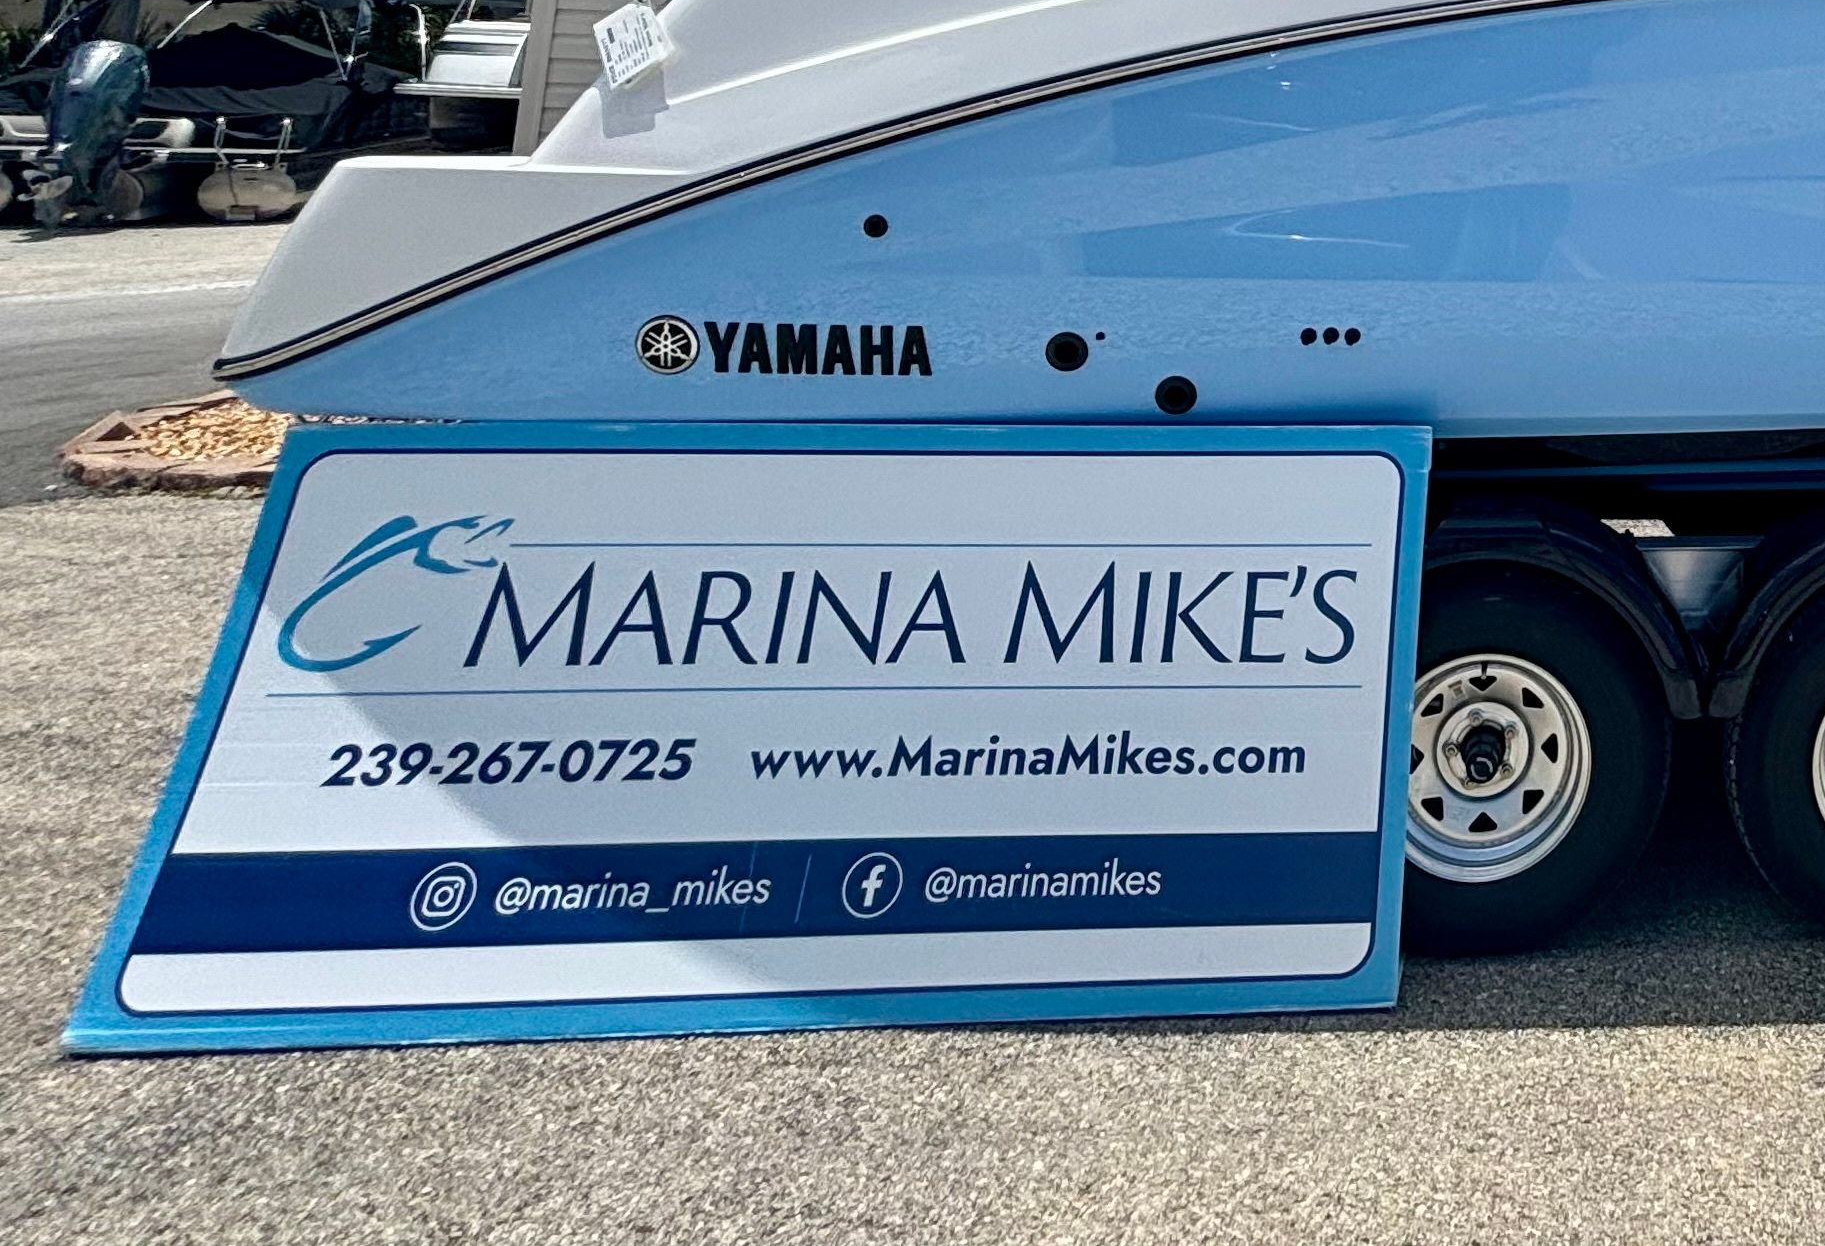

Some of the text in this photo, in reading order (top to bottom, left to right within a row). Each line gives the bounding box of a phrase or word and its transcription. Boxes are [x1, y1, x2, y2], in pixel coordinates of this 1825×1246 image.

[704, 322, 933, 375] YAMAHA
[462, 560, 1360, 668] MARINA MIKE'S
[319, 730, 1307, 787] 239-267-0725 www.MarinaMikes.com
[494, 866, 772, 916] @marina_mikes
[924, 858, 1162, 904] @marinamikes
